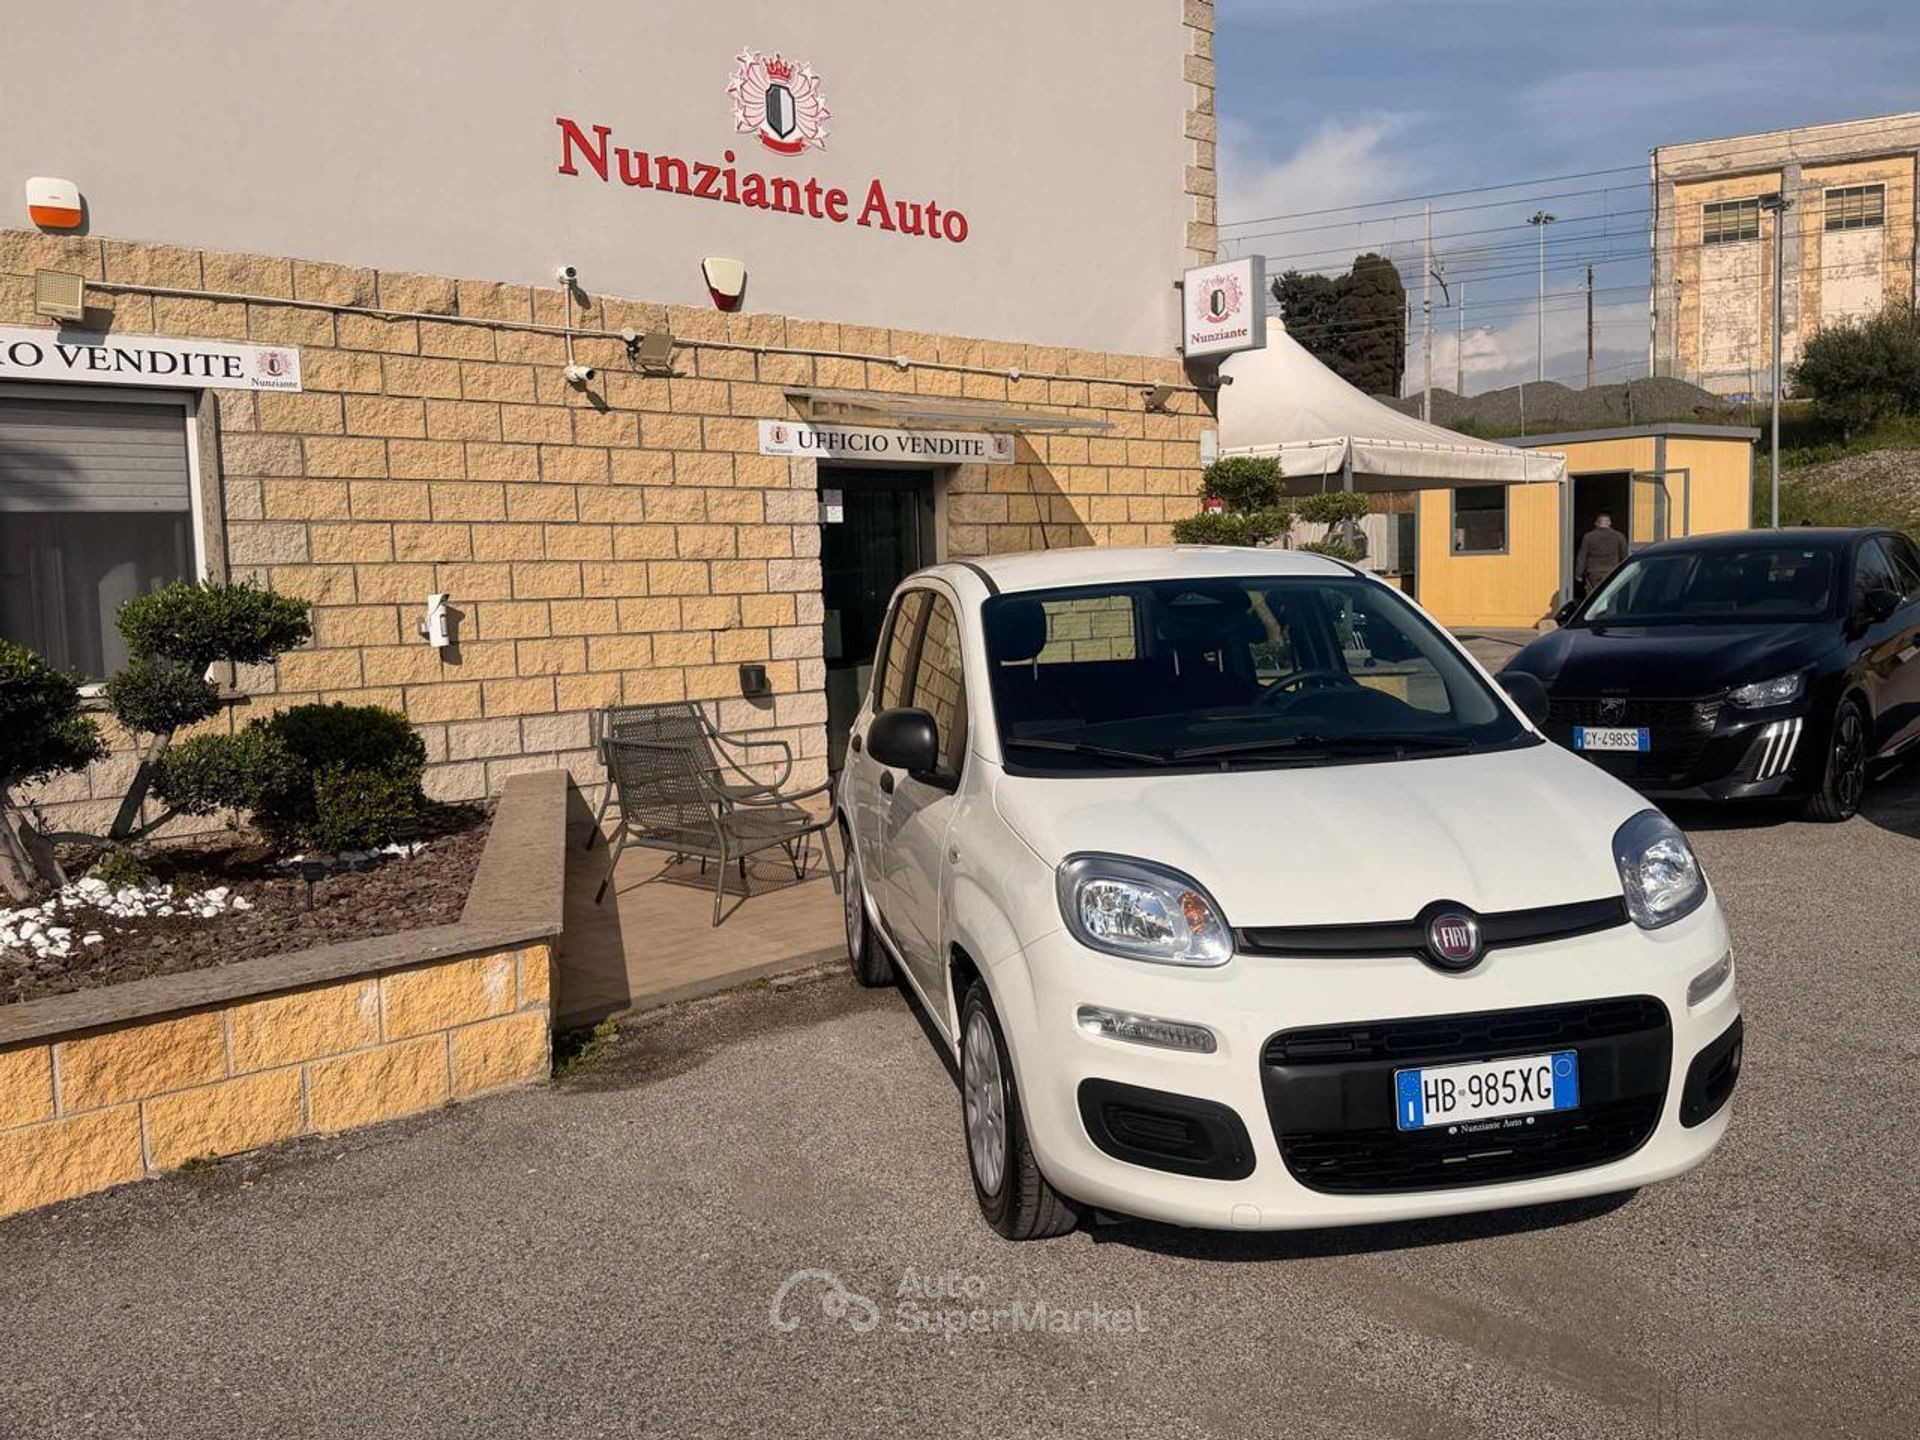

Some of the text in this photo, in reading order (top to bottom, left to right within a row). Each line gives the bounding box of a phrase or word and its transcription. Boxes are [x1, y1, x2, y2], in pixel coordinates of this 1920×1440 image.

[556, 117, 970, 243] Nunziante Auto
[1191, 328, 1248, 344] Nunziante
[0, 340, 244, 379] O VENDITE
[251, 377, 298, 388] Nunziante
[797, 430, 985, 456] UFFICIO VENDITE
[1441, 926, 1468, 948] FIAT
[1424, 1066, 1552, 1114] HB 985XG
[1461, 1119, 1523, 1134] Nunziante Auto
